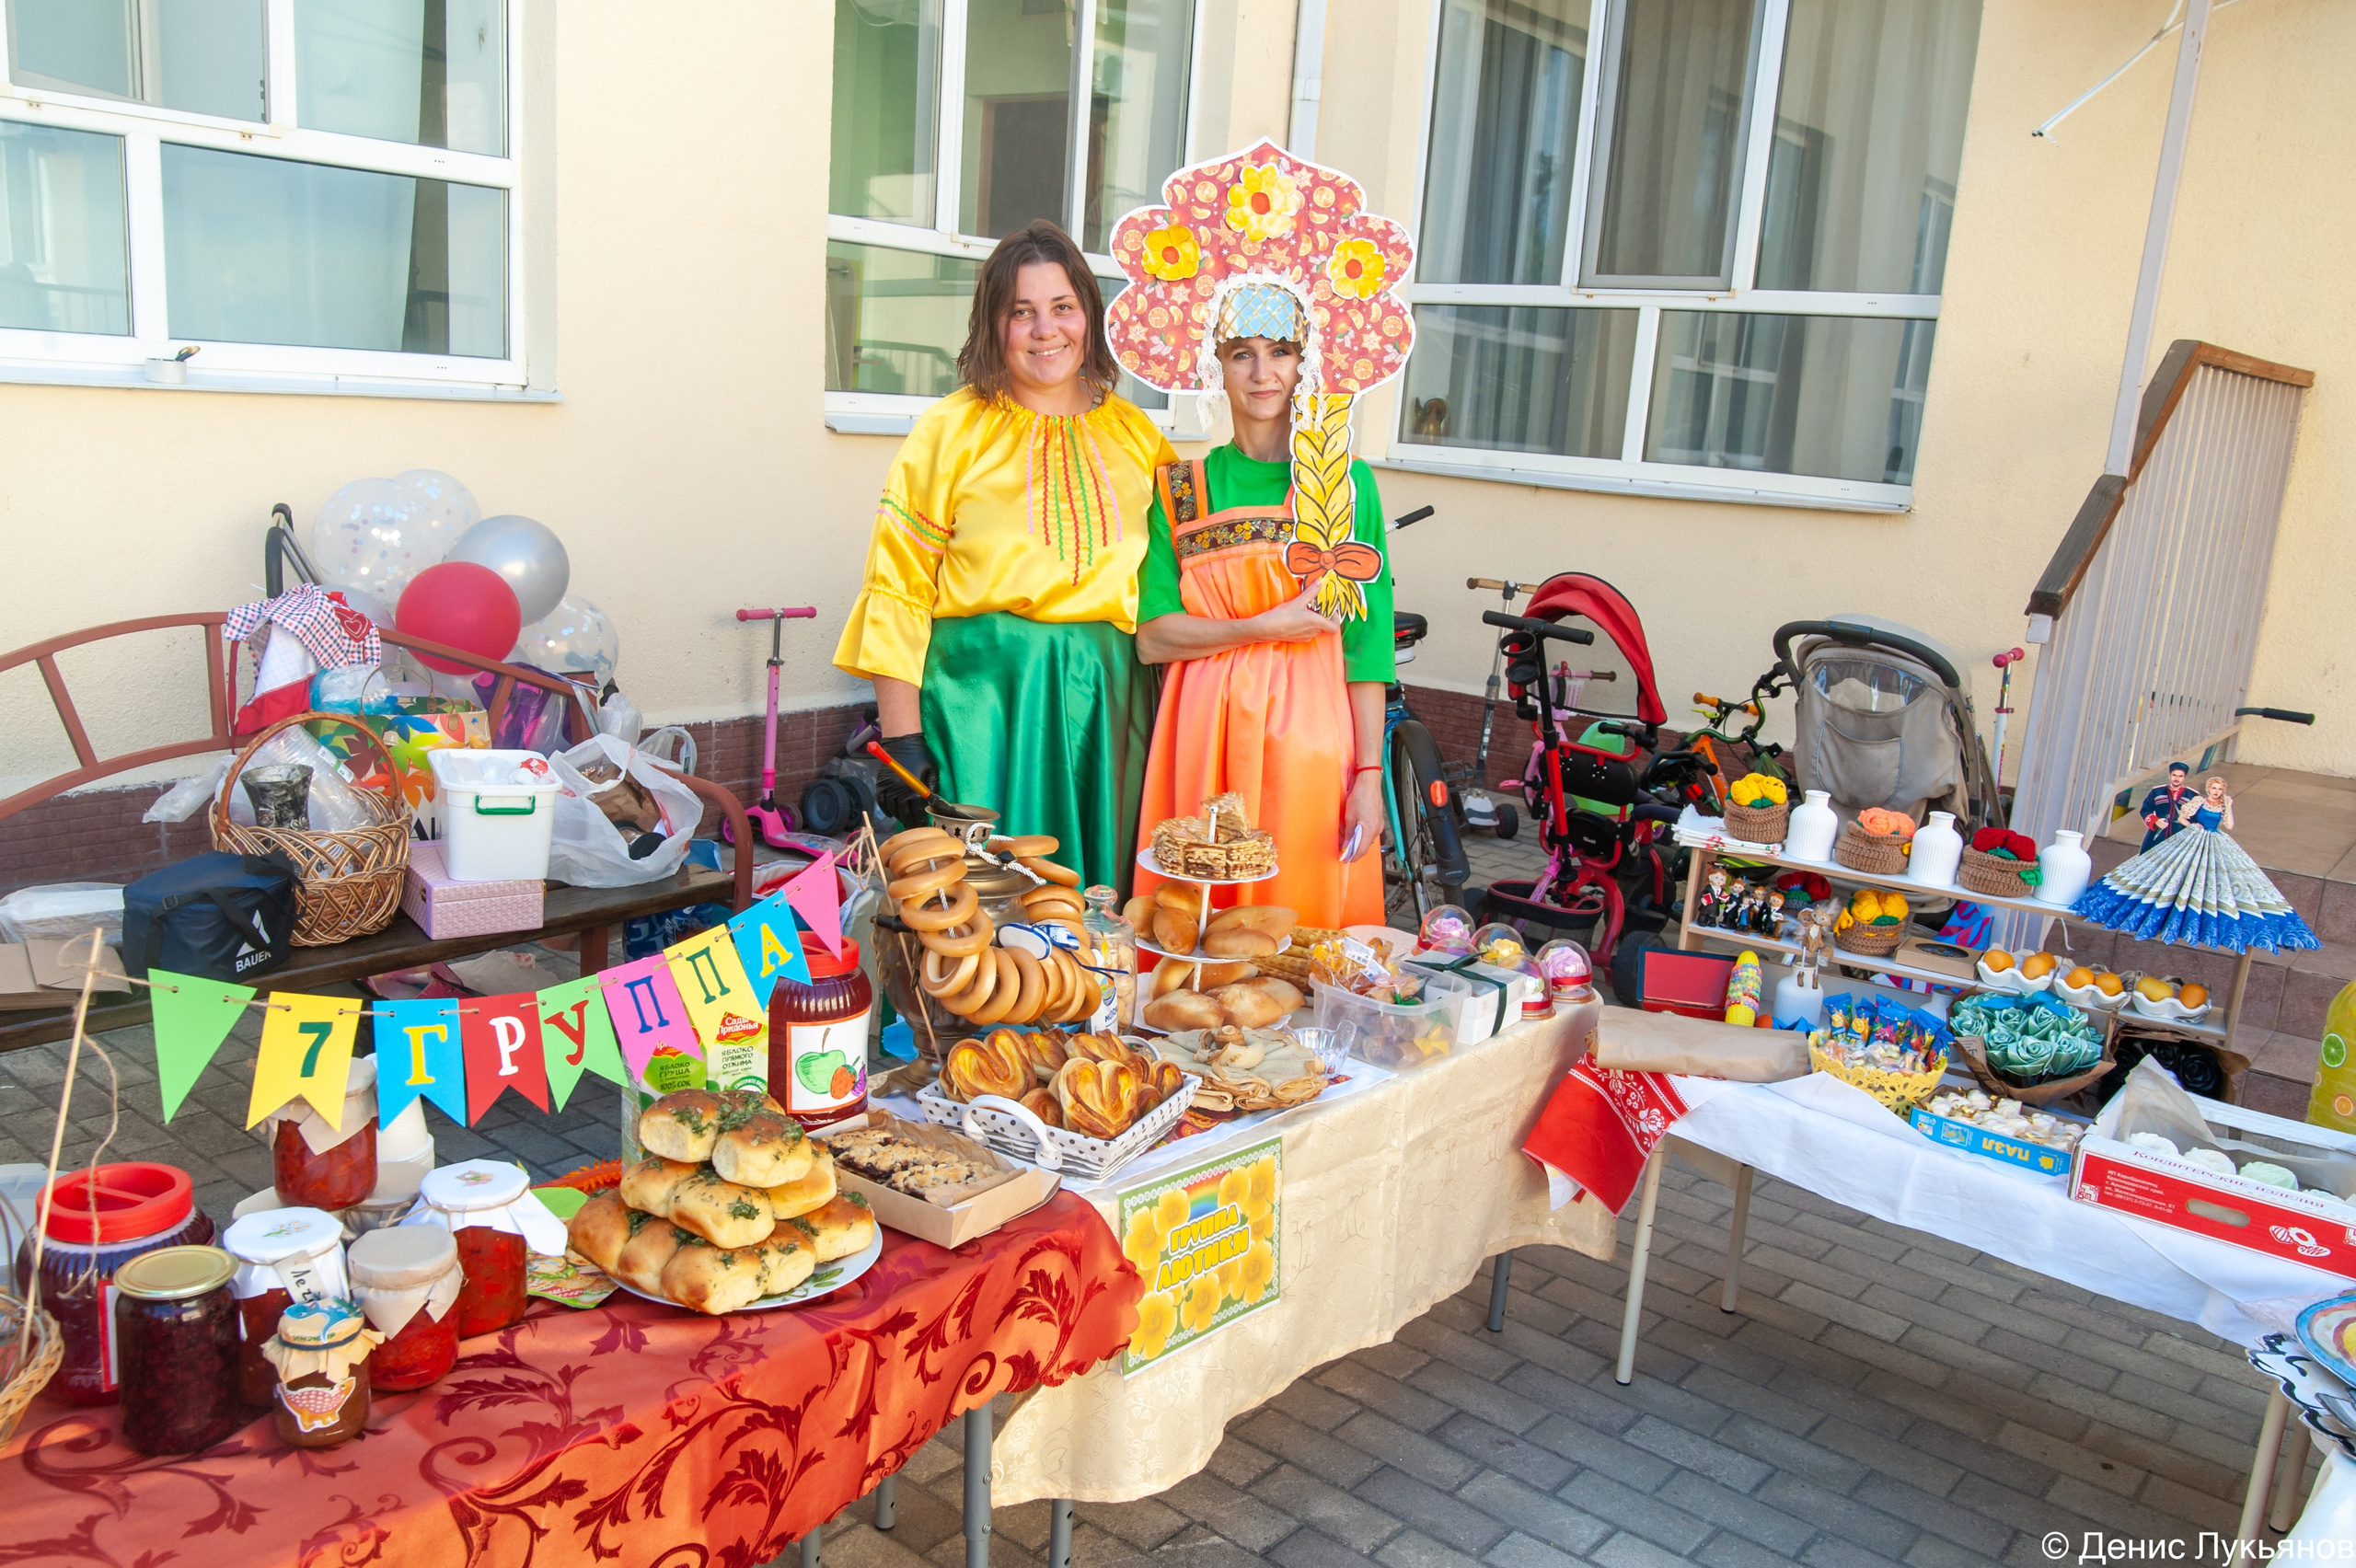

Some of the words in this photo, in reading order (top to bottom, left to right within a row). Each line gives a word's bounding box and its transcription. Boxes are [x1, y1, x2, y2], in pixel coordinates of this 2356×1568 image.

[236, 951, 271, 973] BAUER
[297, 1021, 333, 1078] 7
[402, 922, 795, 1086] ГРУППА
[721, 1045, 754, 1056] ЯБЛОКО
[722, 1053, 754, 1063] ПРЯМОГО
[660, 1062, 690, 1071] ЯБЛОКО
[722, 1059, 753, 1069] ОТЖИМА
[659, 1067, 690, 1078] ГРУША
[660, 1080, 676, 1090] 100%
[677, 1080, 691, 1089] СОК
[1981, 1137, 2030, 1161] ПАЗЛ
[1170, 1205, 1239, 1252] ГРУППА
[1156, 1228, 1250, 1292] ЛЮТИКИ
